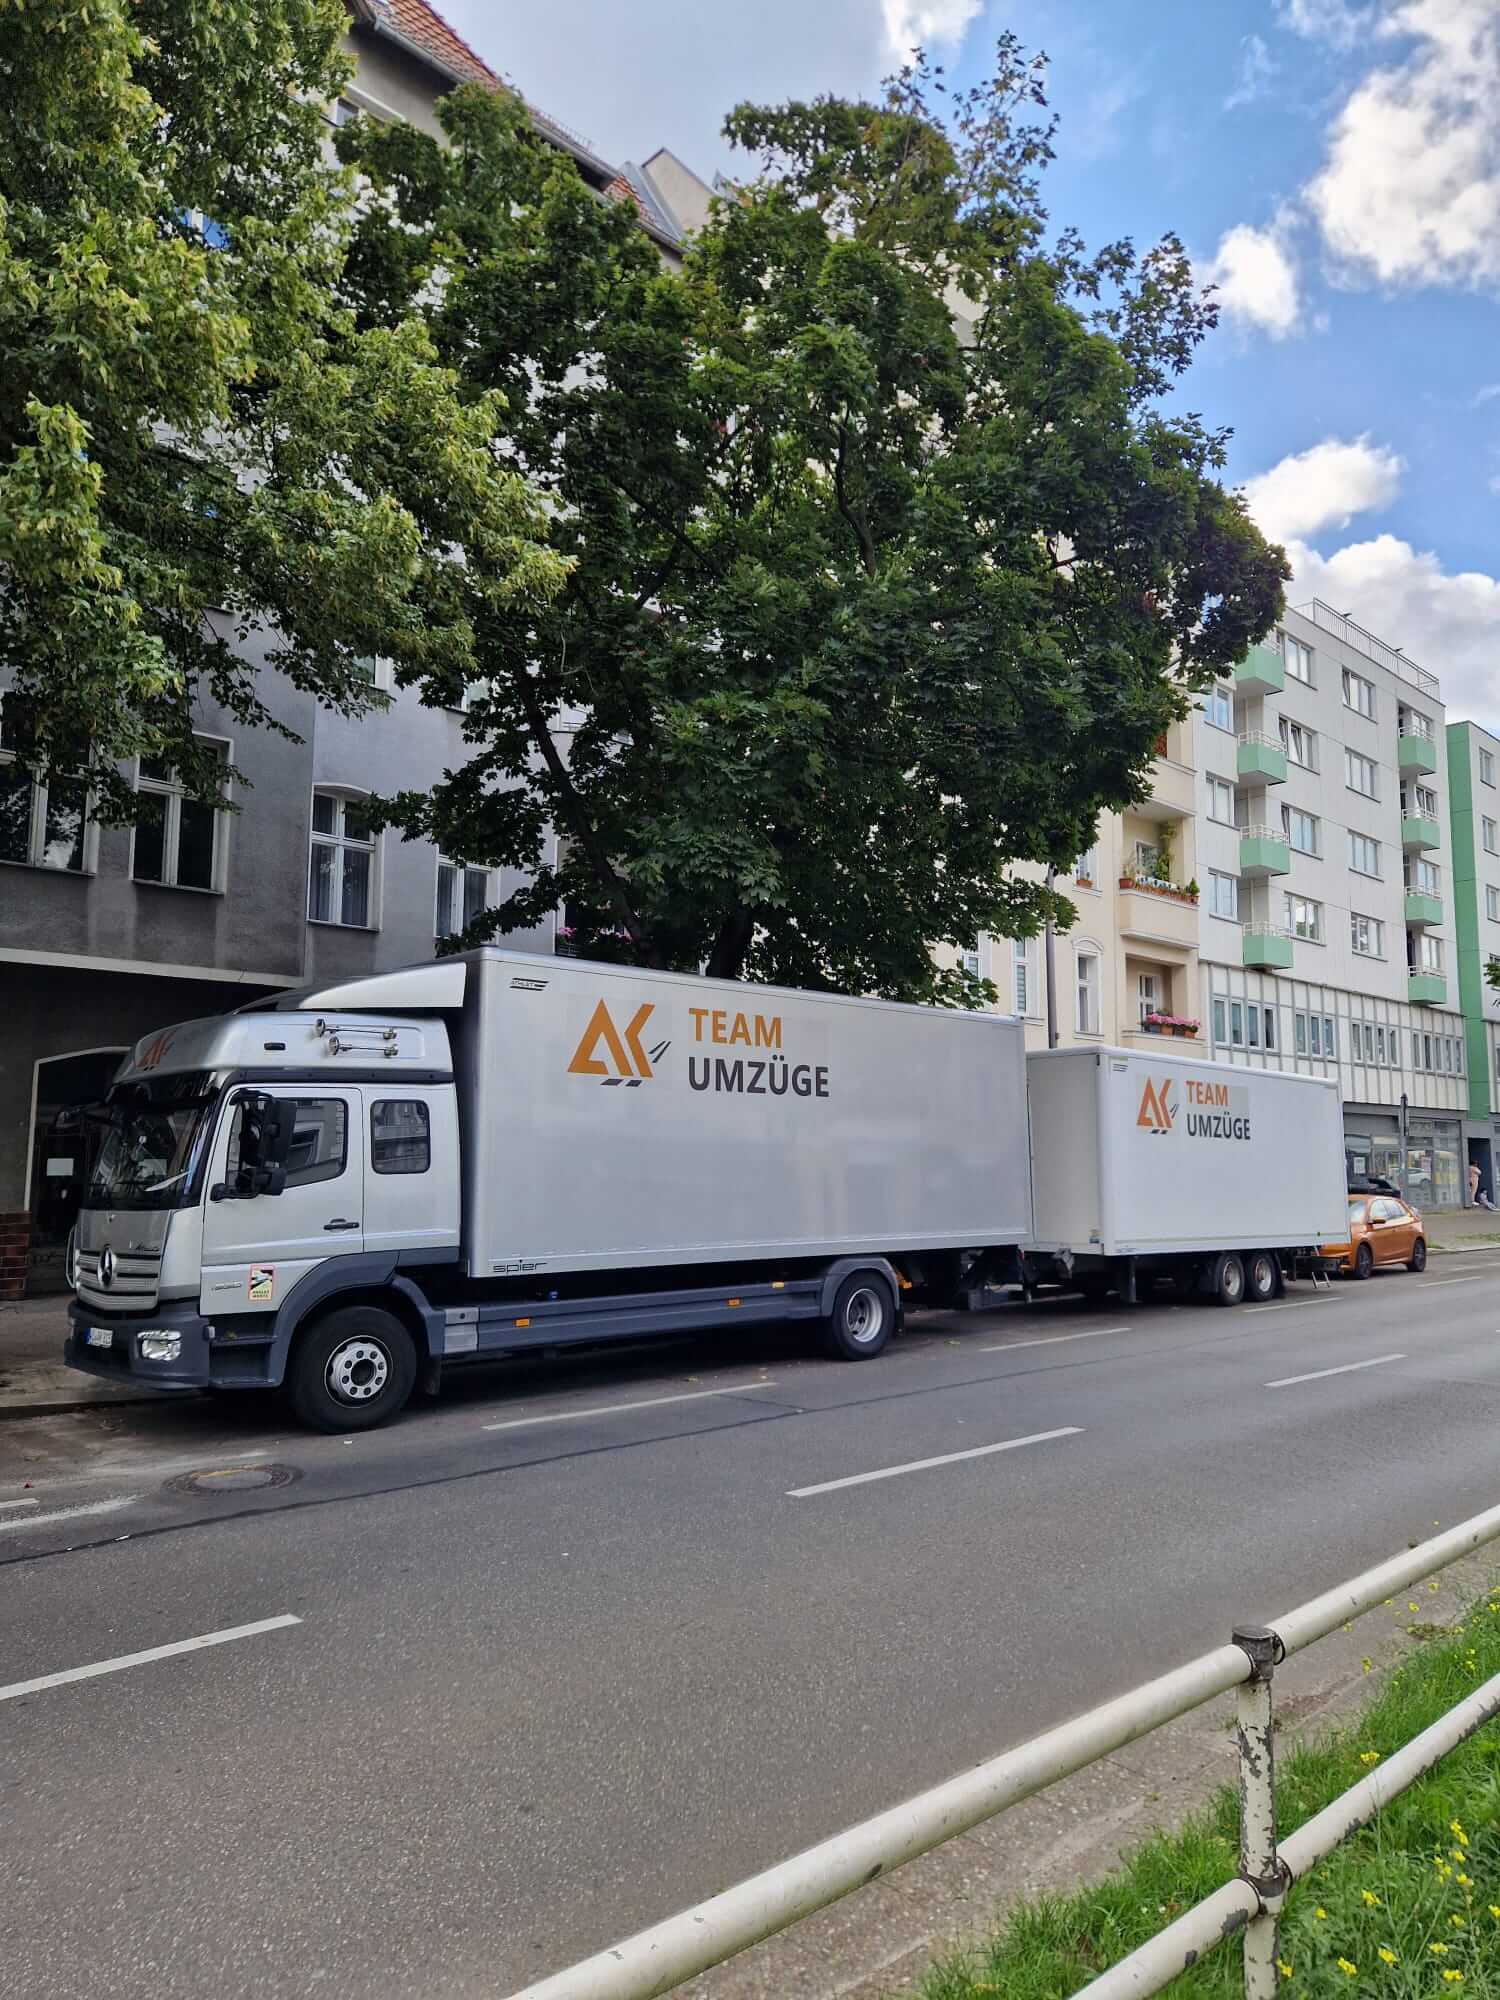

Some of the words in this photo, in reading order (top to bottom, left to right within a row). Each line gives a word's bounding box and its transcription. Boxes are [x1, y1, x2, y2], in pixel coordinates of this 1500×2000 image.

[688, 1007, 782, 1049] TEAM
[688, 1054, 830, 1098] UMZÜGE
[1185, 1080, 1228, 1107] TEAM
[1186, 1111, 1251, 1140] UMZÜGE
[492, 1259, 548, 1275] spier
